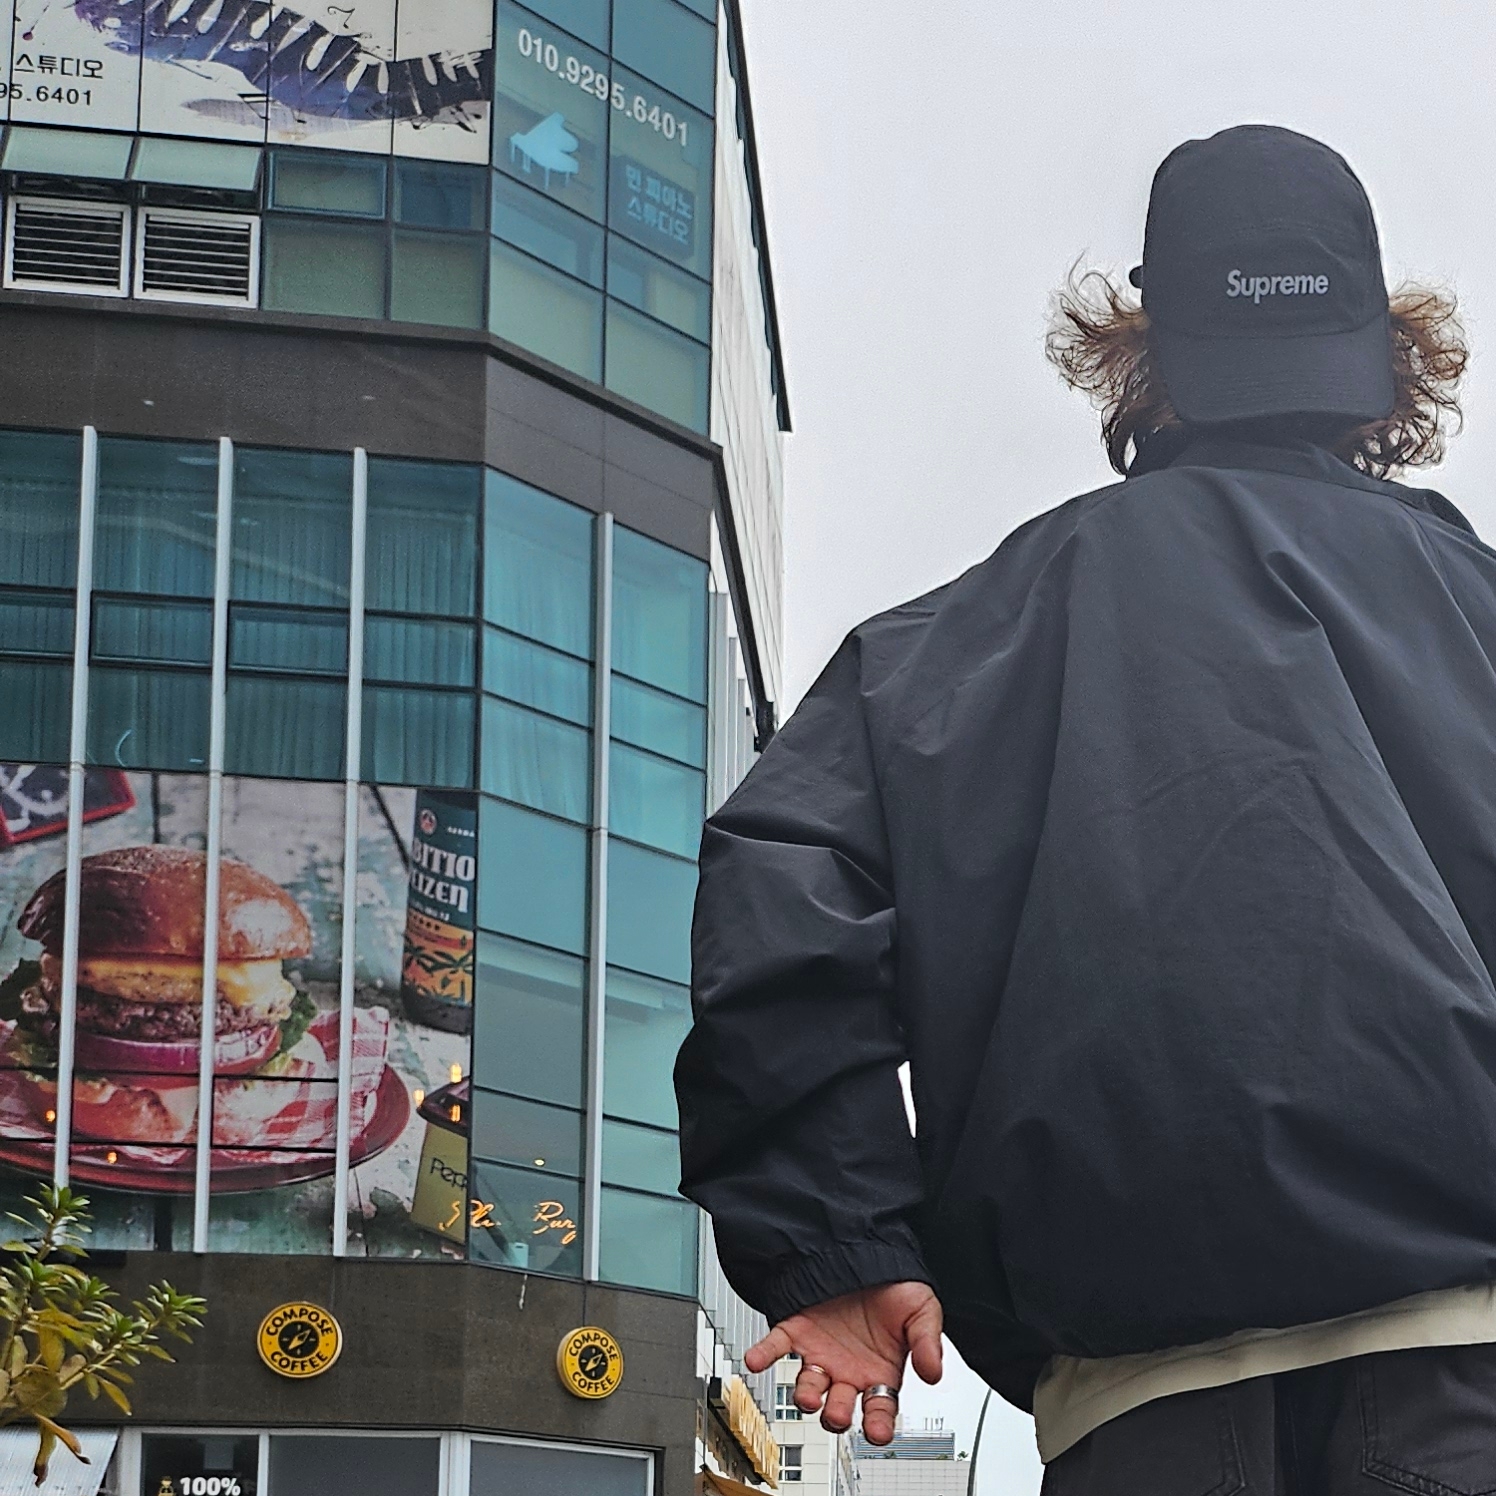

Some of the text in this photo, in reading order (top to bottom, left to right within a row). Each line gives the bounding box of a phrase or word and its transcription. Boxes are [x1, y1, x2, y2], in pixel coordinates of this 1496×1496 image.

[14, 54, 103, 79] 스튜디오
[518, 29, 688, 147] 010.9295.6401
[628, 196, 688, 246] 스튜디오
[1226, 269, 1329, 304] Supreme
[266, 1307, 333, 1337] COMPOSE
[270, 1351, 328, 1372] COFFEE
[569, 1332, 619, 1362] COMPOSE
[572, 1371, 615, 1393] COFFEE
[180, 1477, 241, 1496] 100%
